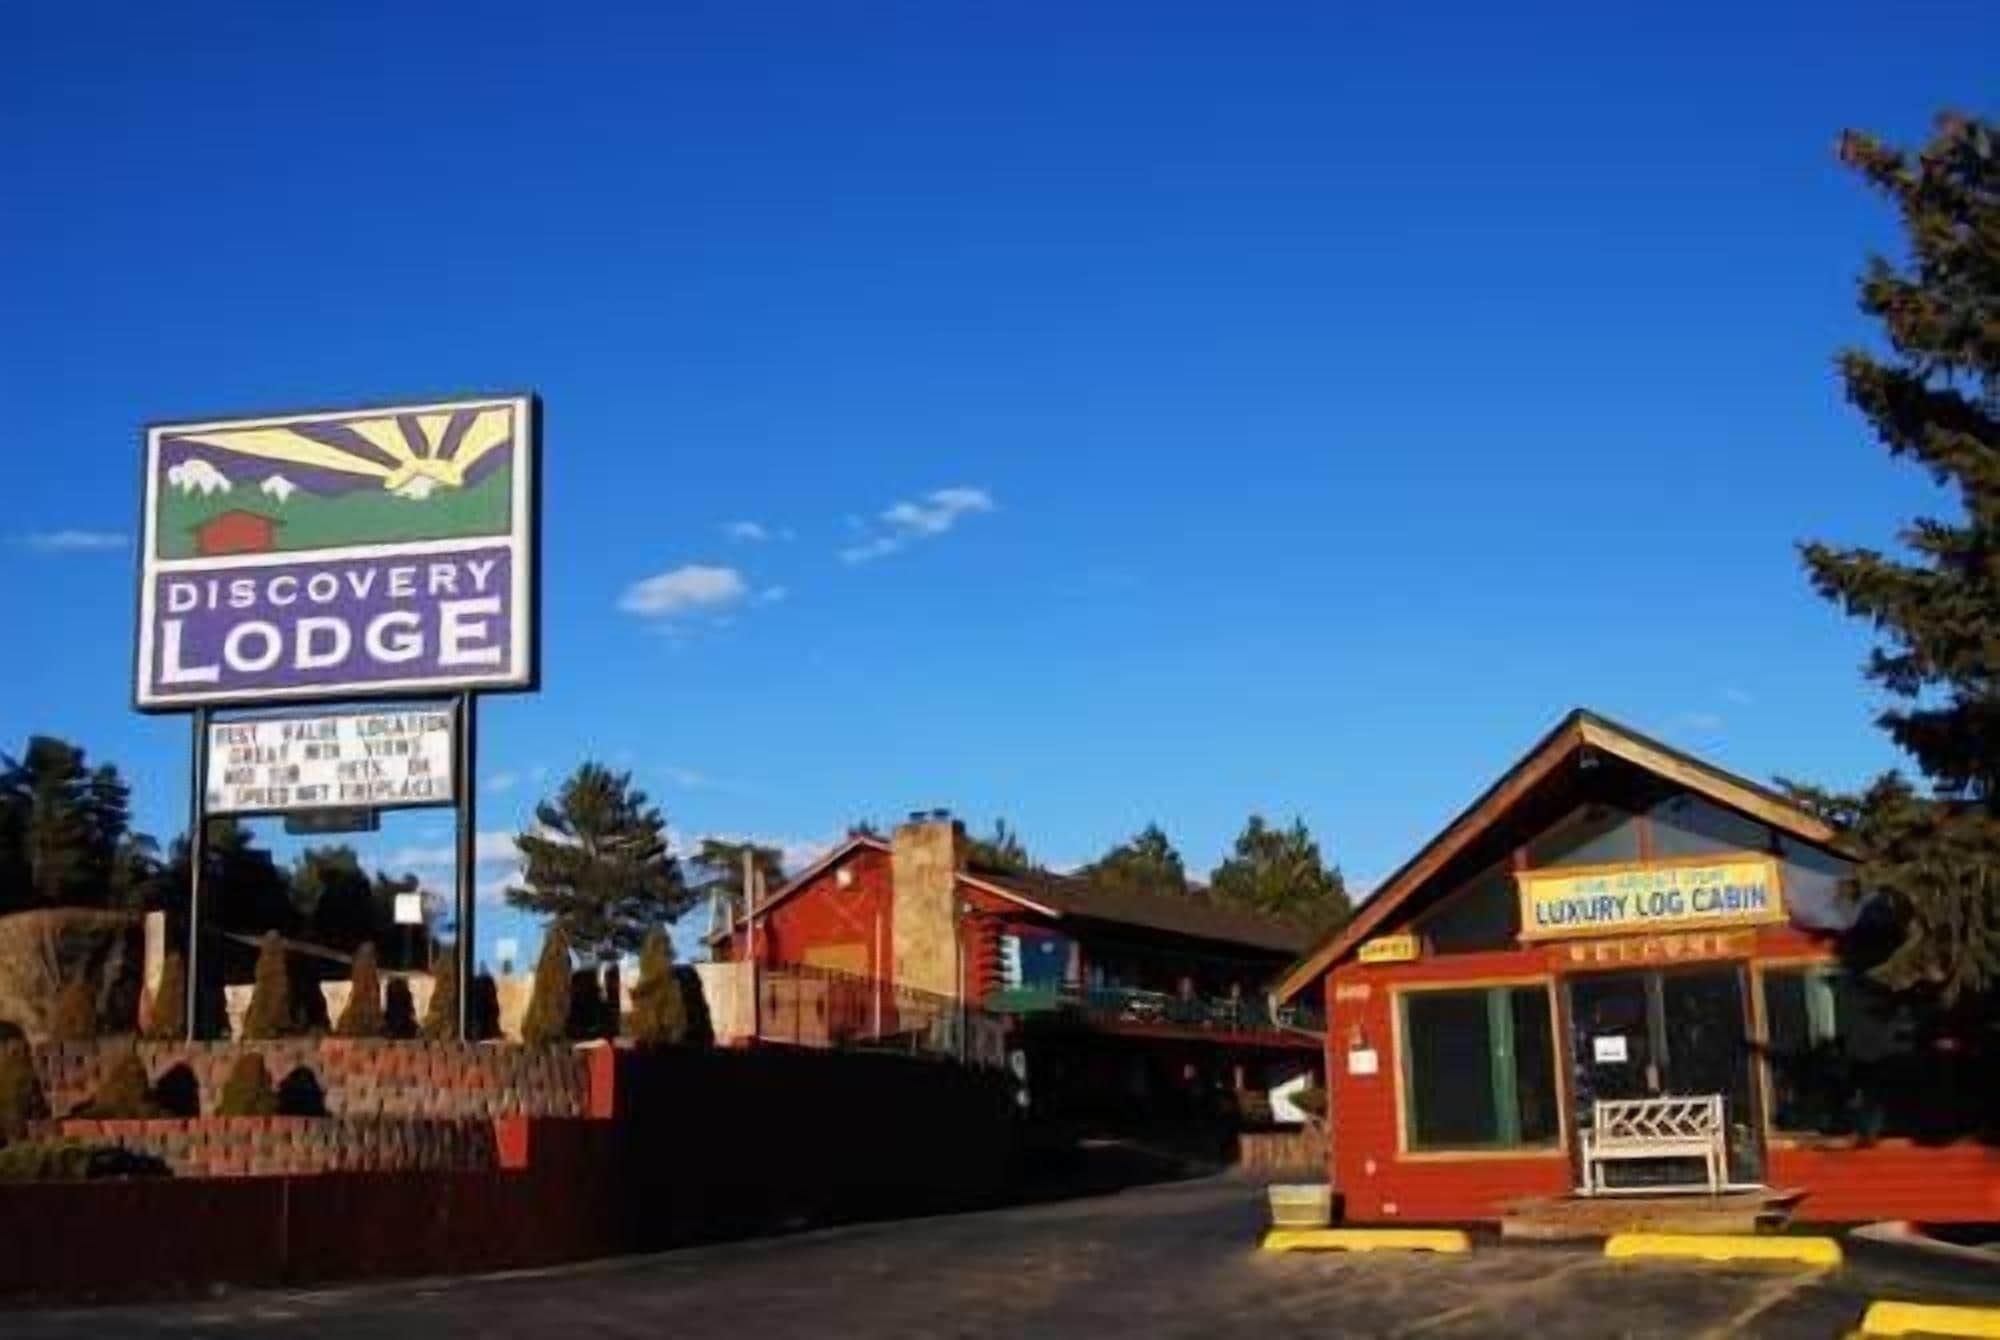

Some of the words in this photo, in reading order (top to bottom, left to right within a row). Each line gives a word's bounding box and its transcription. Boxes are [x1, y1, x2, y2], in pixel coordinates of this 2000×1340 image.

[168, 560, 495, 612] DISCOVERY
[160, 597, 501, 684] LODGE
[1536, 895, 1629, 925] LUXURY
[1636, 889, 1684, 917] LOG
[1692, 883, 1766, 912] CABIN
